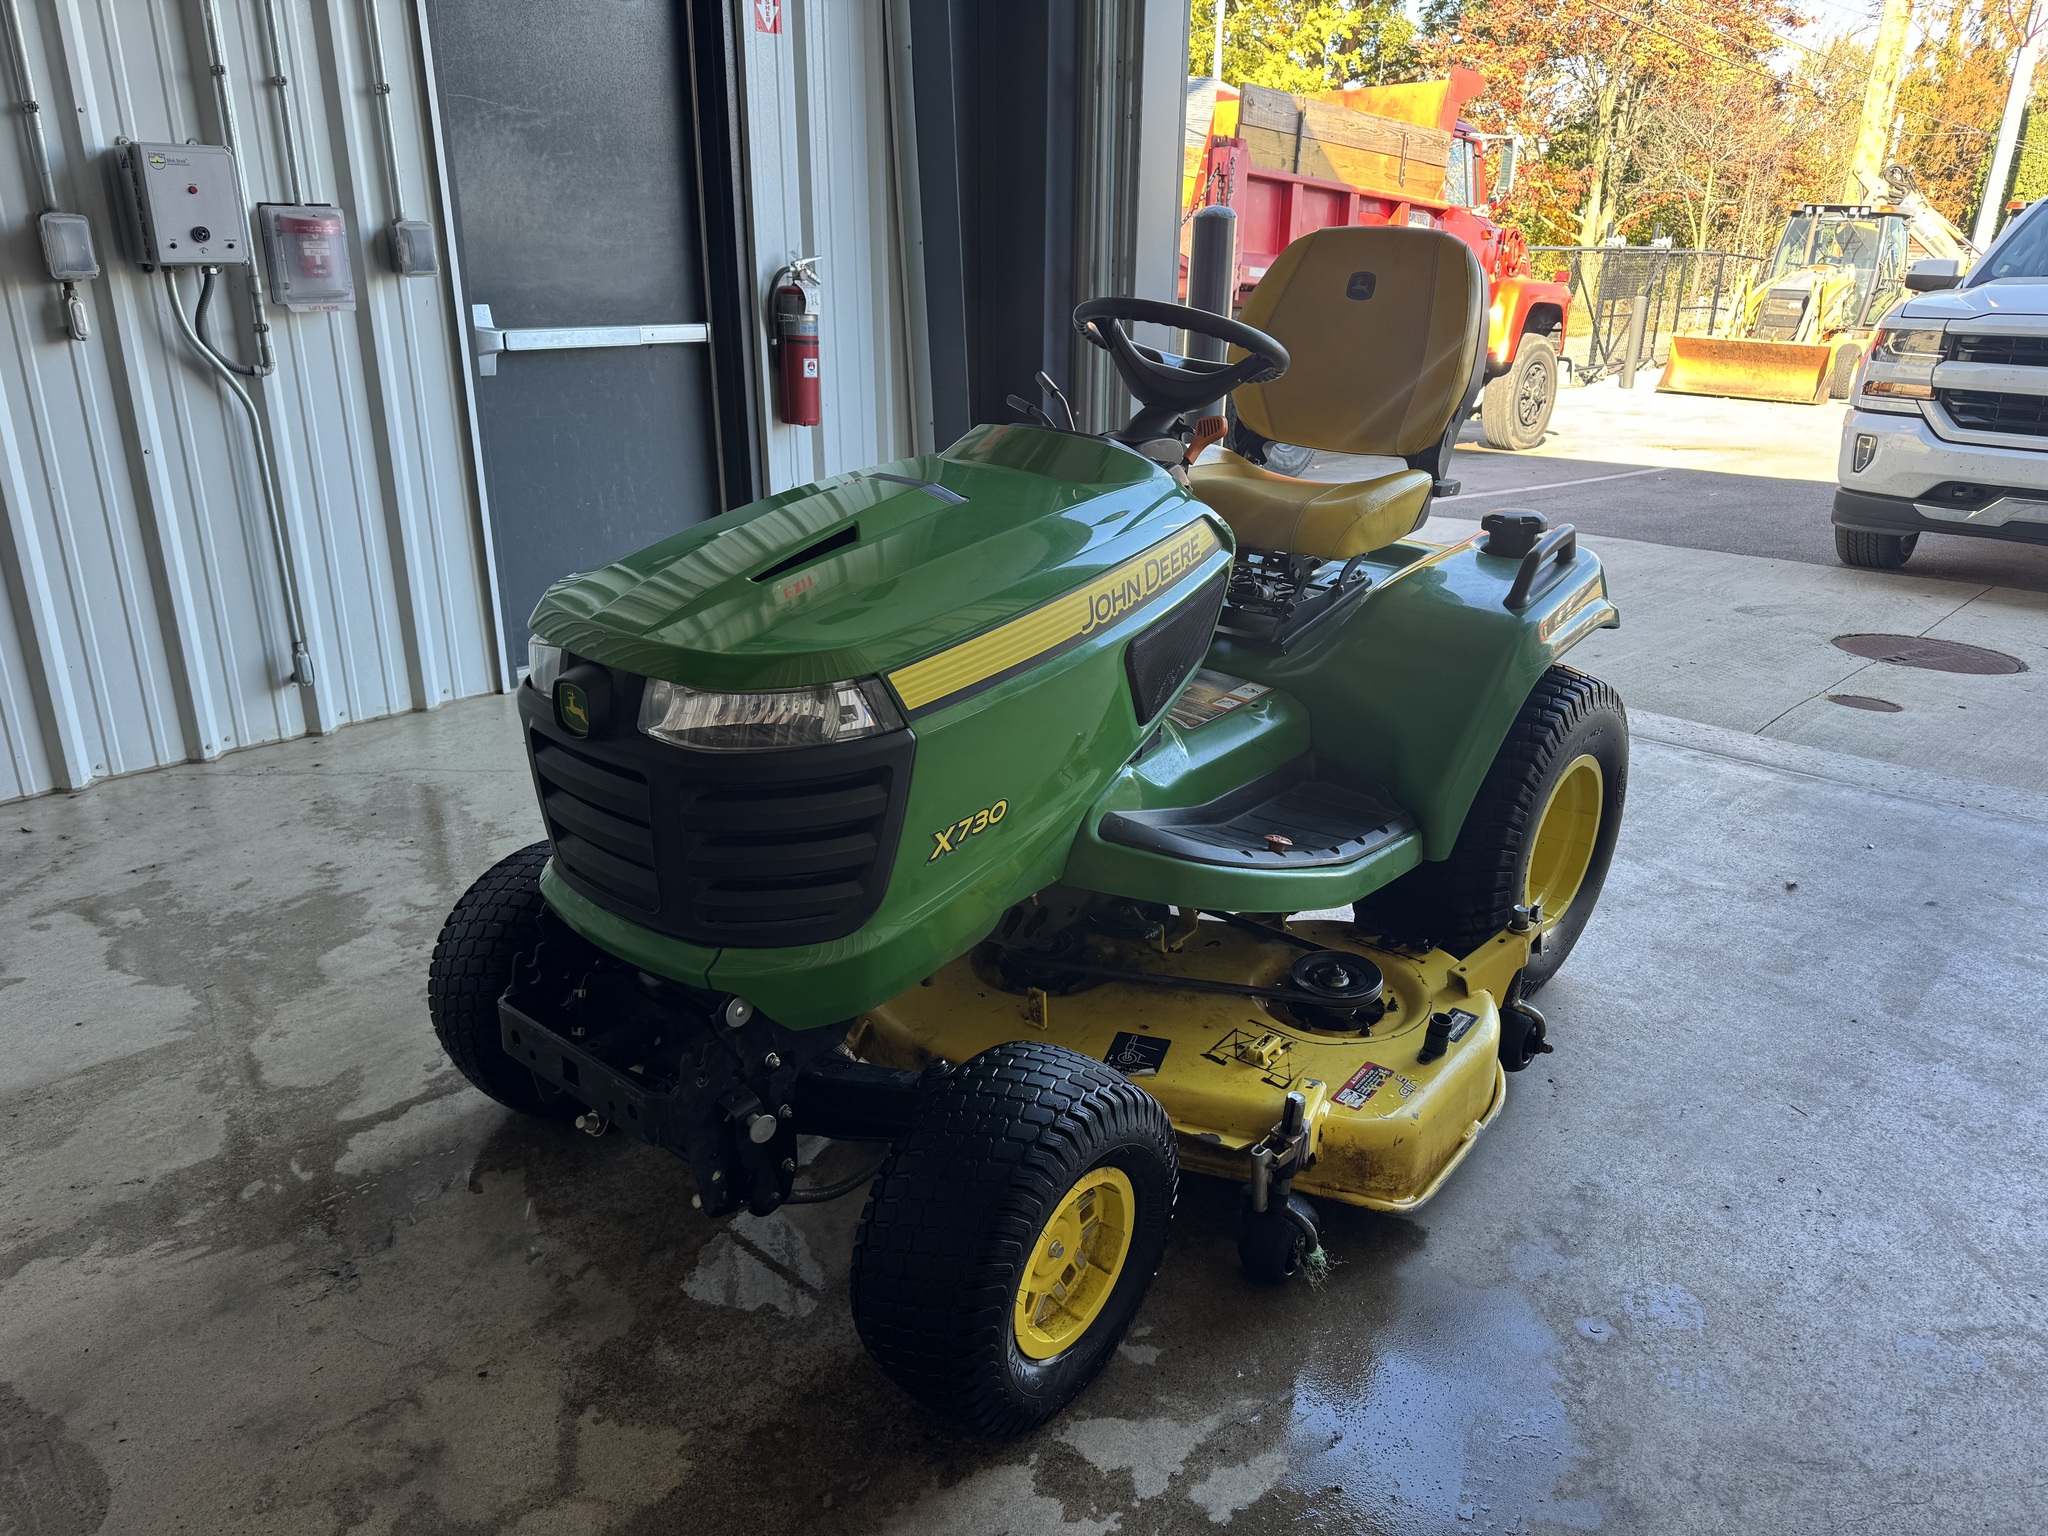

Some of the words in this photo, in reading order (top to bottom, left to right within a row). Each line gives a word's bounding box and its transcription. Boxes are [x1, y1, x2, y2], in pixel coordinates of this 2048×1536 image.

[1081, 573, 1142, 633] JOHN
[1144, 533, 1201, 593] DEERE
[928, 799, 1008, 862] X730
[1353, 1067, 1367, 1082] DANGER
